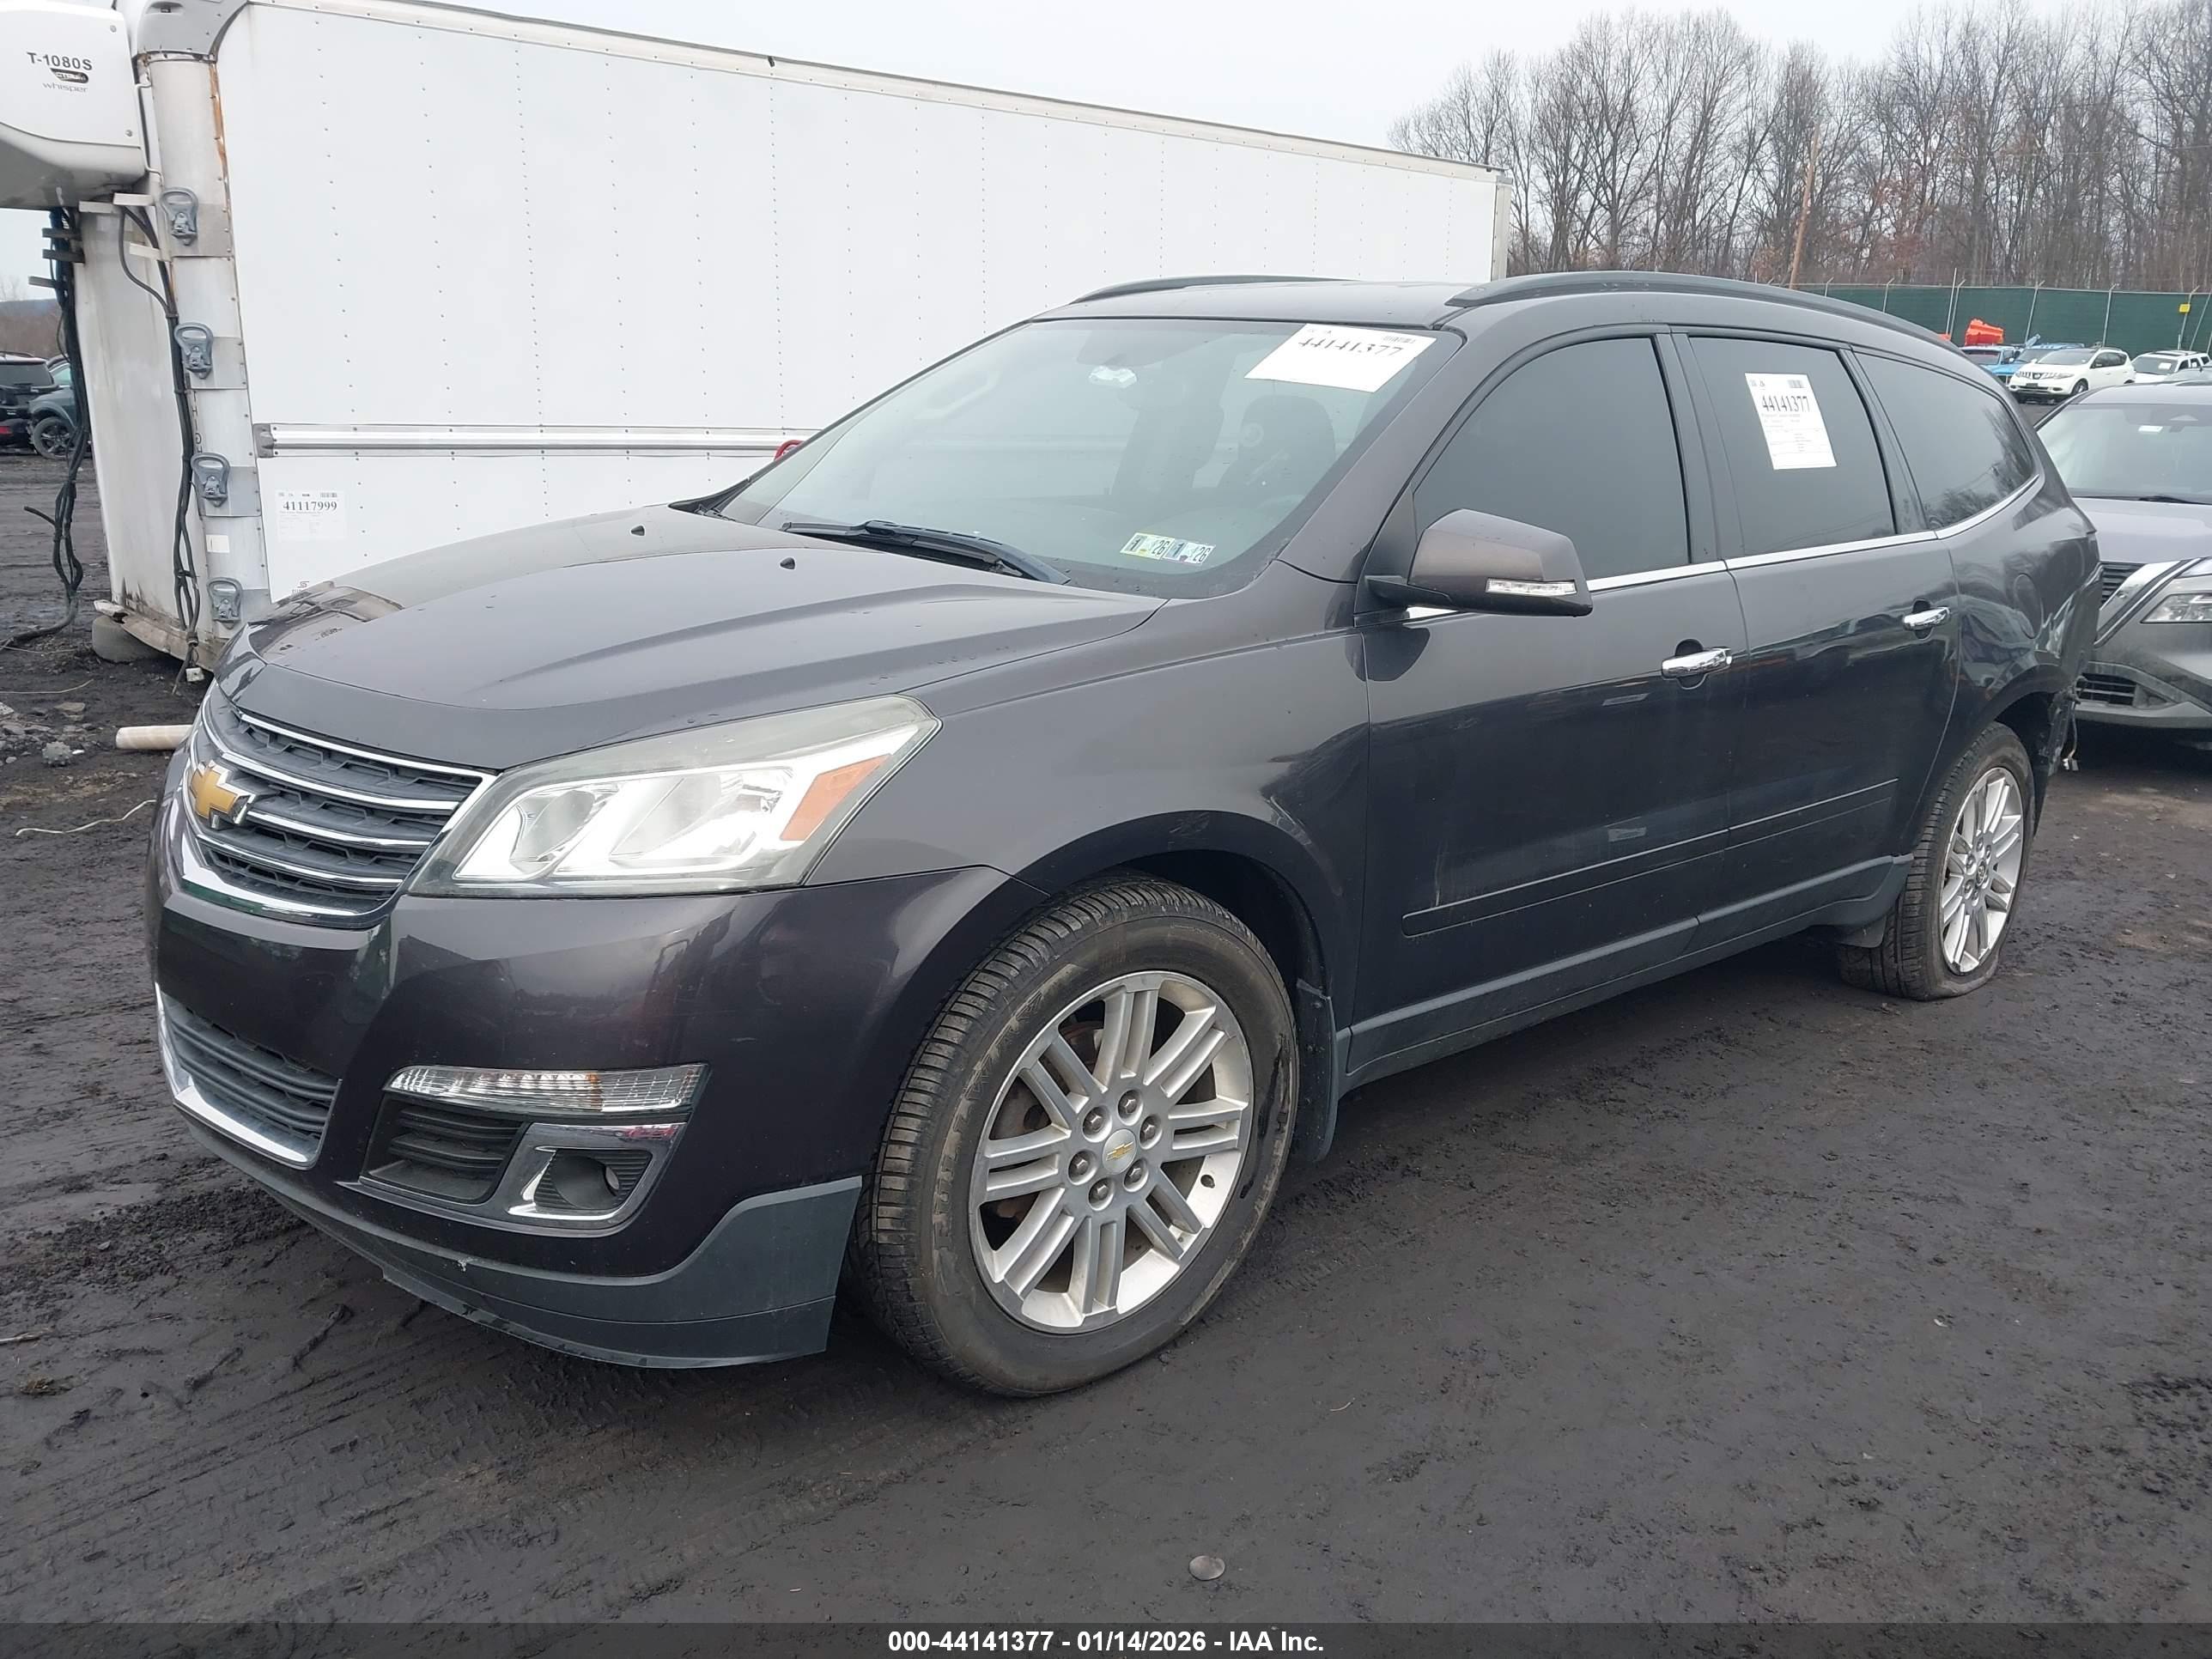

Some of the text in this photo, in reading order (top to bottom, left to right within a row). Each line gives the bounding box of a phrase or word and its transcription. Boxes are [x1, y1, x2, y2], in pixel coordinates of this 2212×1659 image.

[27, 52, 93, 70] T-1080S
[42, 82, 88, 94] whisper
[1761, 395, 1810, 412] 44141377
[283, 501, 337, 511] 41117999
